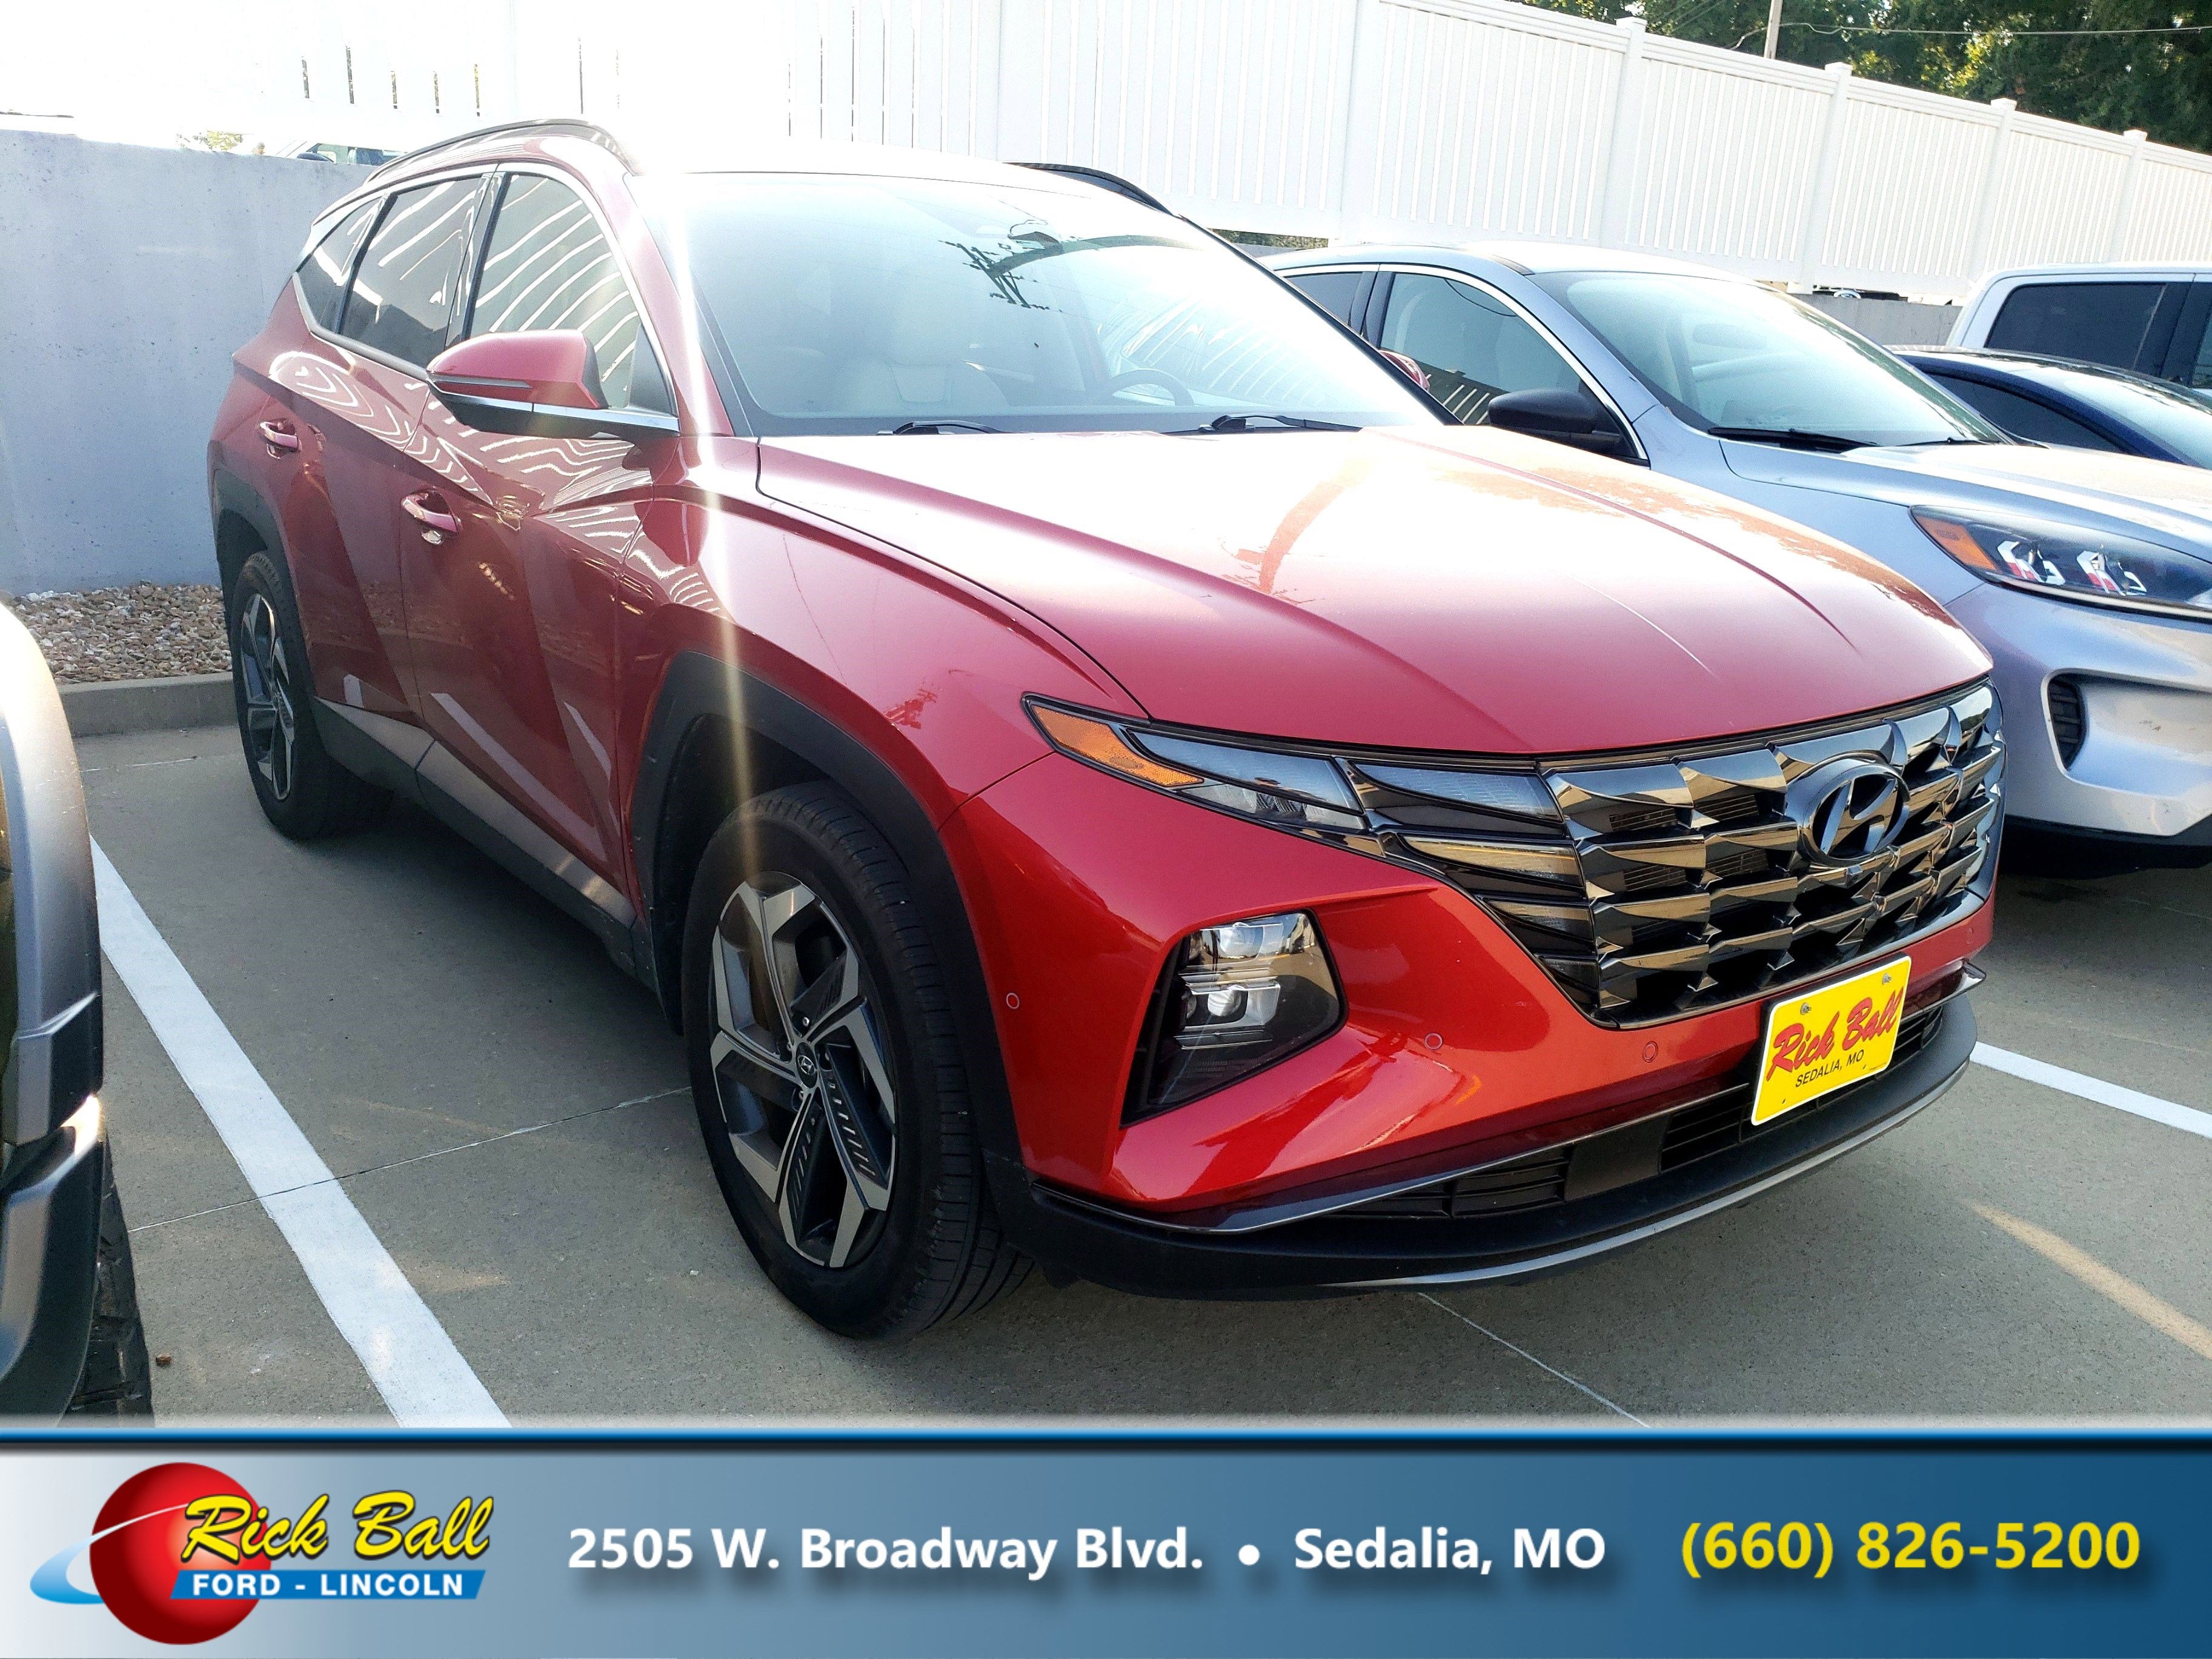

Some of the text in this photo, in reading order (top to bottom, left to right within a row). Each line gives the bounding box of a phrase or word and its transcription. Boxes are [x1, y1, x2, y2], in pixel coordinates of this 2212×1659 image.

[1766, 987, 1904, 1082] Rick Ball
[1795, 1059, 1842, 1088] SEDALIA,
[1846, 1049, 1864, 1067] MO
